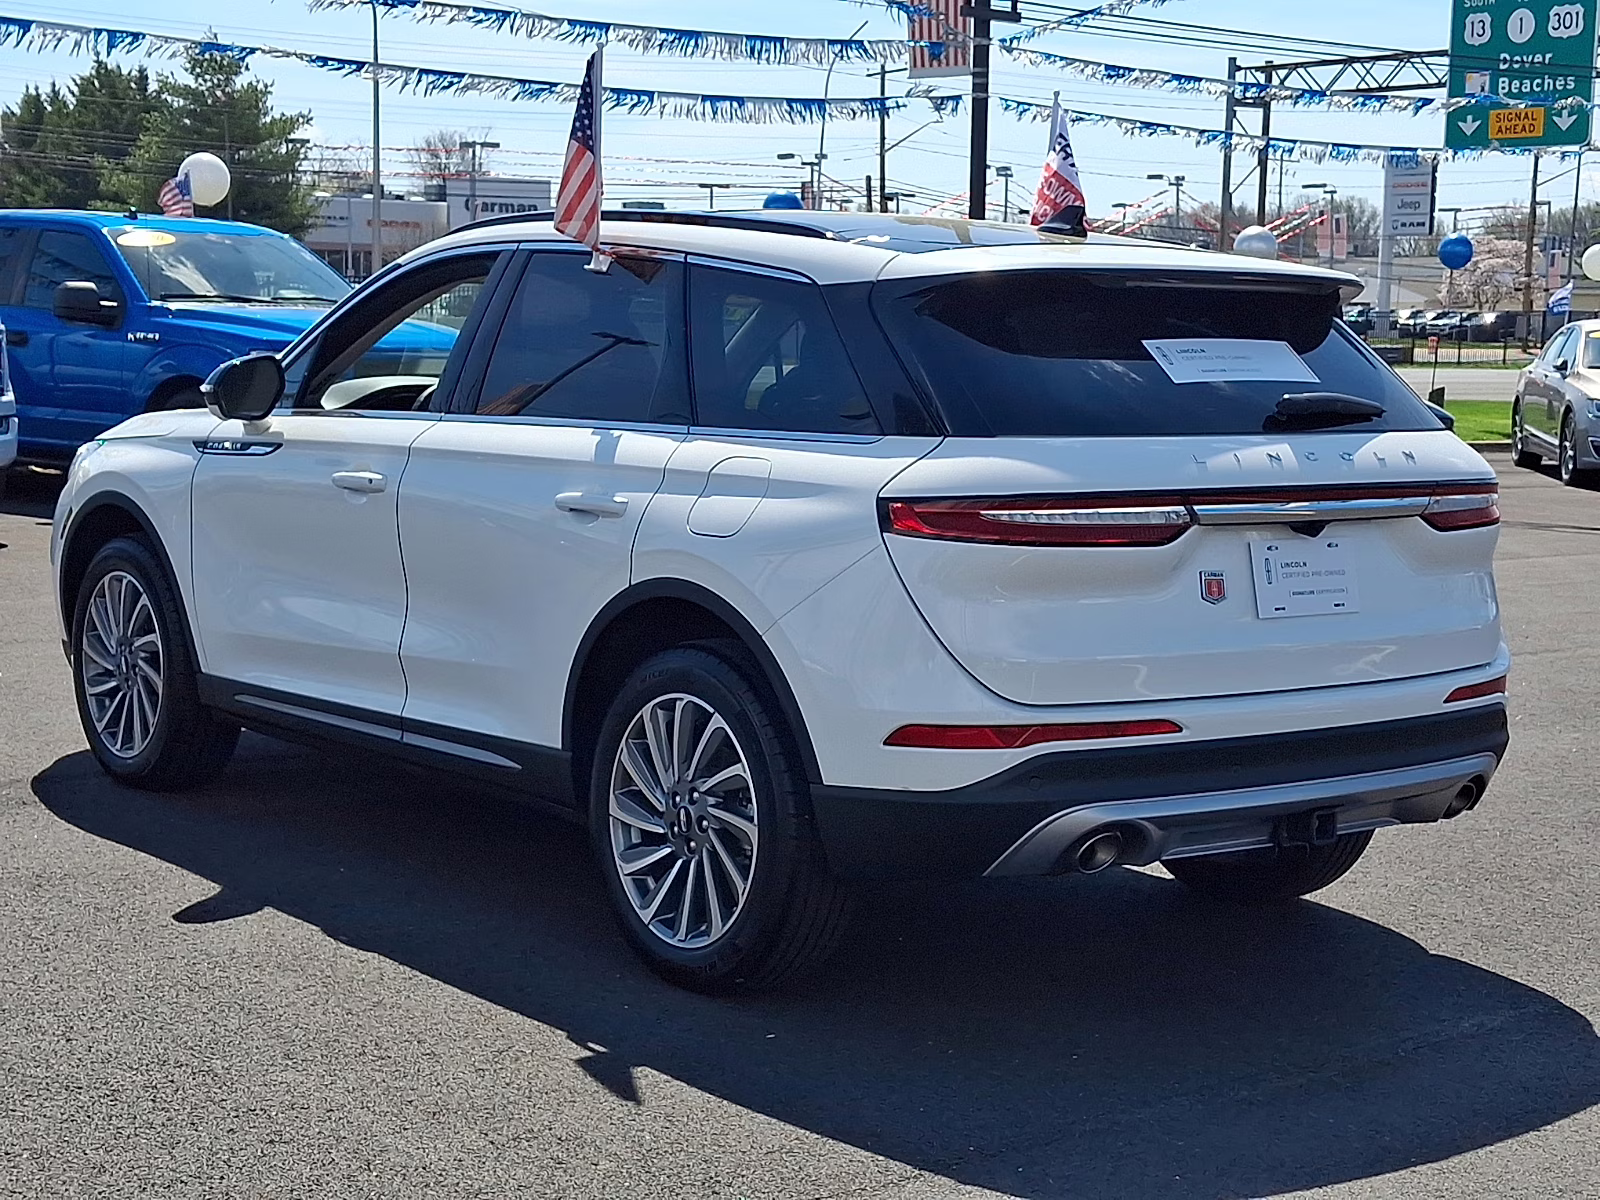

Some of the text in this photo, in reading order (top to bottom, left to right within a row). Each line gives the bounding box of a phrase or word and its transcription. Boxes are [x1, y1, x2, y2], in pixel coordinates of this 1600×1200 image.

[1471, 11, 1580, 38] 13 1 301
[1499, 53, 1553, 69] Dover
[1498, 75, 1576, 93] Beaches
[1495, 111, 1537, 123] SIGNAL
[1495, 124, 1536, 135] AHEAD
[1397, 198, 1421, 211] Jeep
[1191, 451, 1416, 464] LINCOLN
[1282, 571, 1310, 579] CERTIFIED
